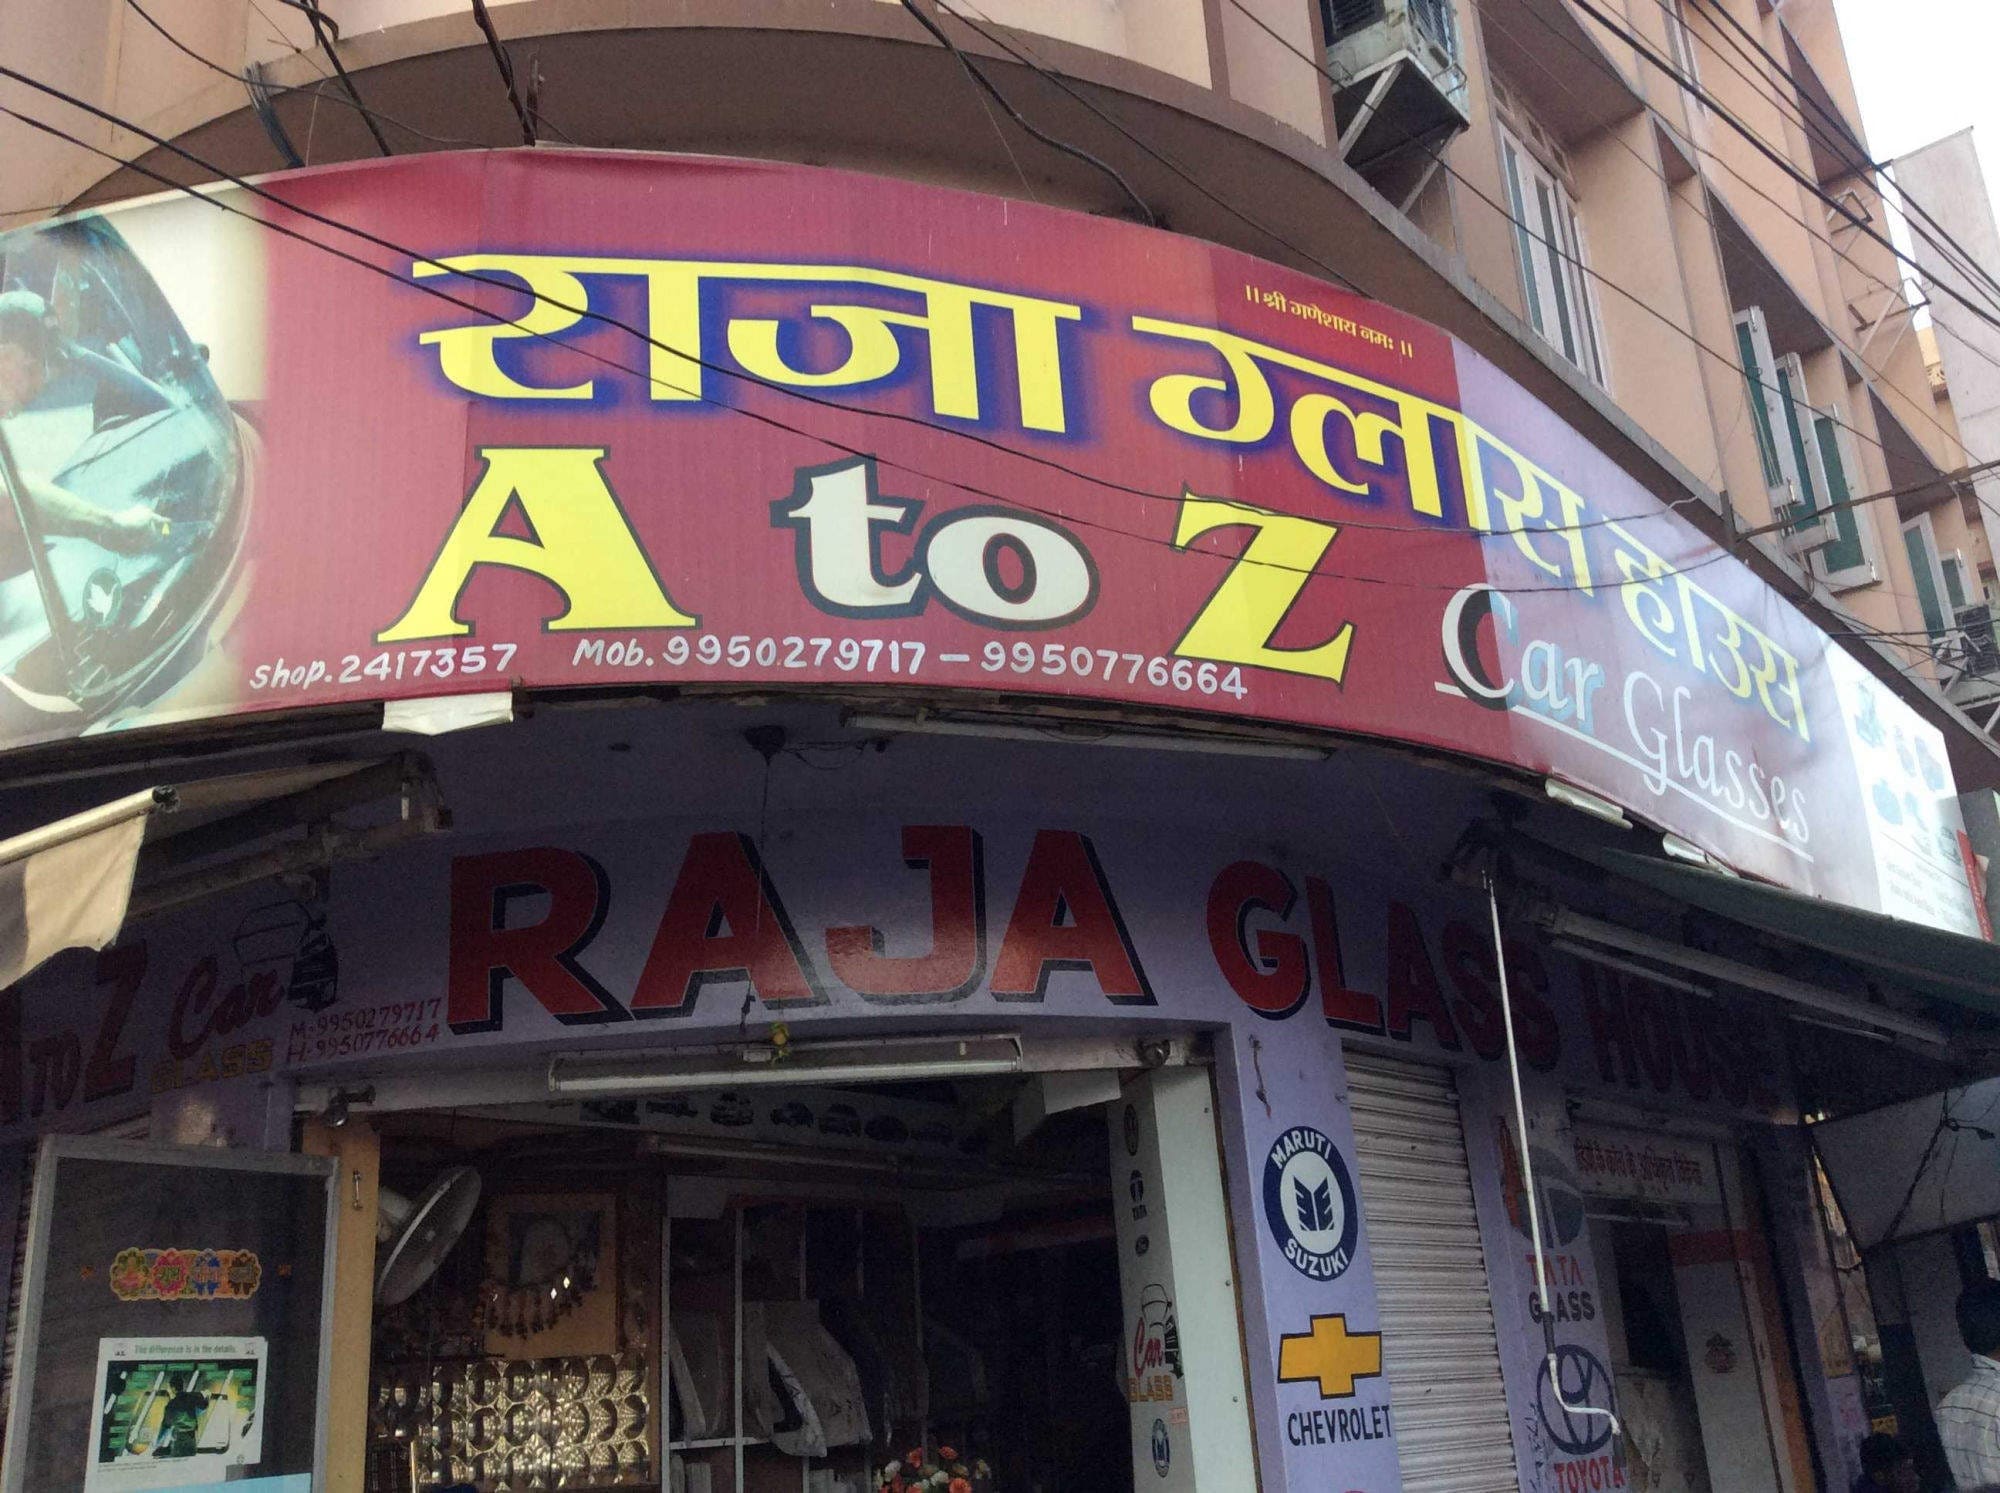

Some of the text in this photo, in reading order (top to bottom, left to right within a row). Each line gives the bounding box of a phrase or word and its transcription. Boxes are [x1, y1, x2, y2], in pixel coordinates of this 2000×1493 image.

[1289, 300, 1357, 337] गणेशाय
[412, 253, 1811, 743] राजा ग्लास हाउस
[373, 447, 1356, 690] A to Z
[981, 641, 1248, 699] 9950776664
[1442, 583, 1811, 844] Car Glasses
[448, 826, 1158, 1034] RAJA
[1207, 860, 1561, 1072] GLASS
[1271, 1130, 1331, 1170] MARUTI
[1284, 1238, 1349, 1277] SUZUKI
[1529, 1290, 1596, 1324] GASS
[1288, 1404, 1391, 1446] CHEVROLET
[1554, 1455, 1626, 1493] TOYOTA
